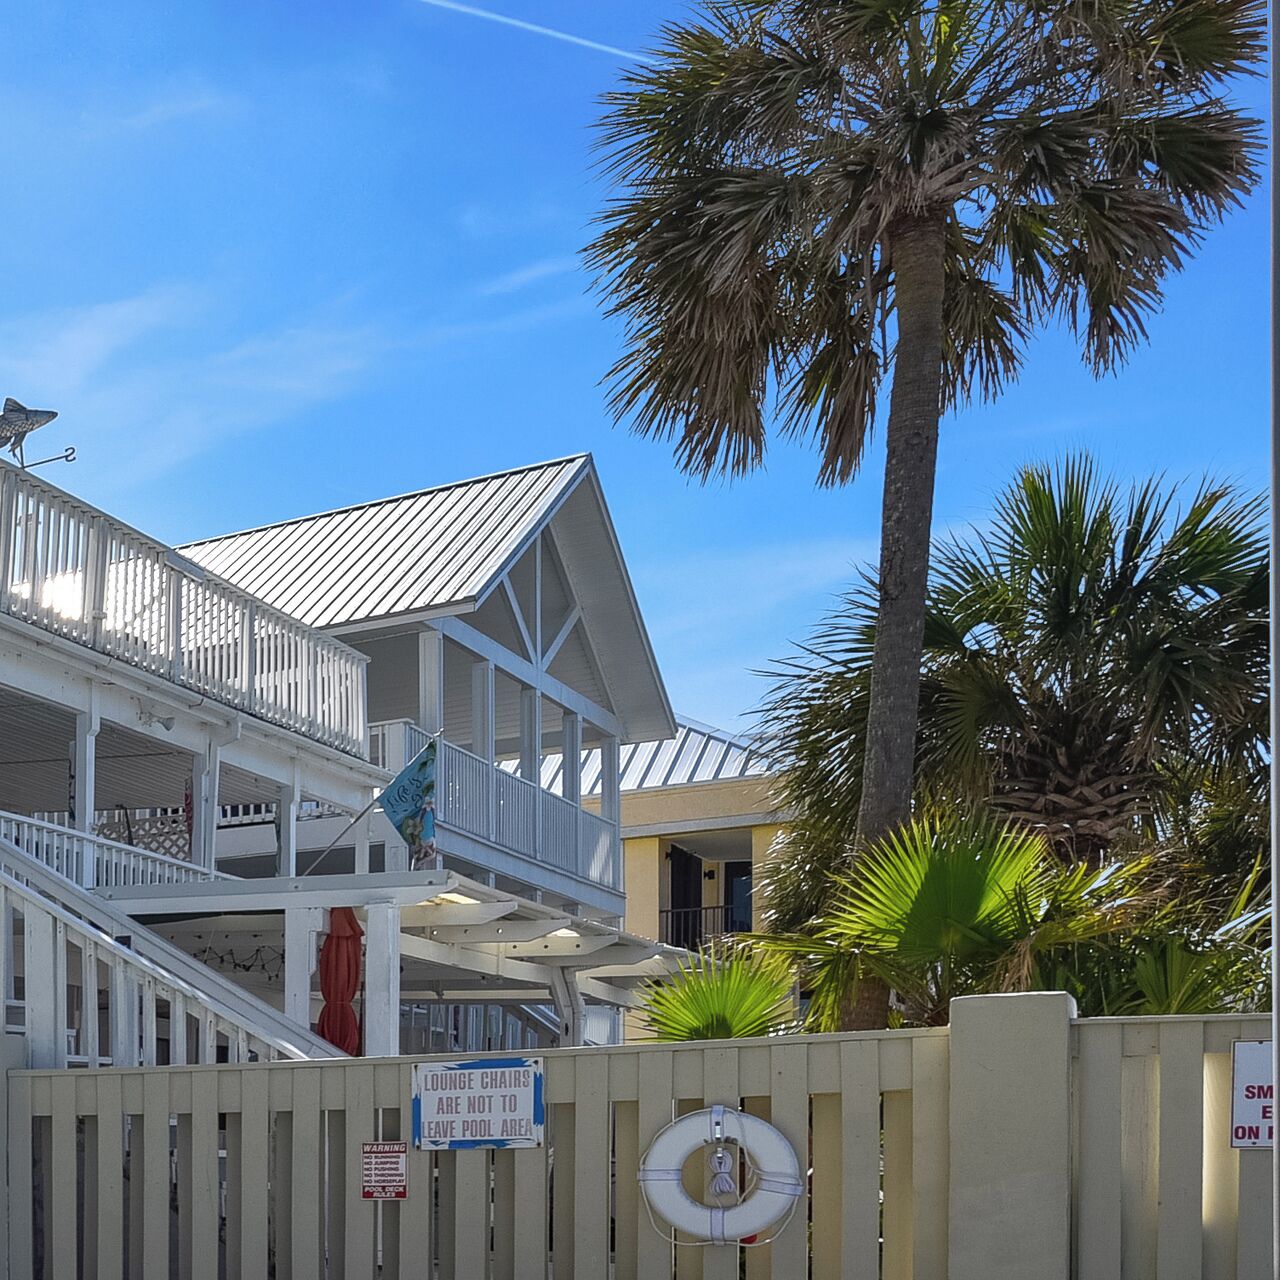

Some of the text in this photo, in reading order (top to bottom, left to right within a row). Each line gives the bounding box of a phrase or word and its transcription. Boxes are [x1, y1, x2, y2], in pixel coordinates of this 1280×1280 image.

[424, 1070, 530, 1091] LOUNGE CHAIRS
[436, 1095, 517, 1115] ARE NOT TO
[422, 1118, 533, 1139] LEAVE POOL AREA
[1234, 1126, 1259, 1140] ON
